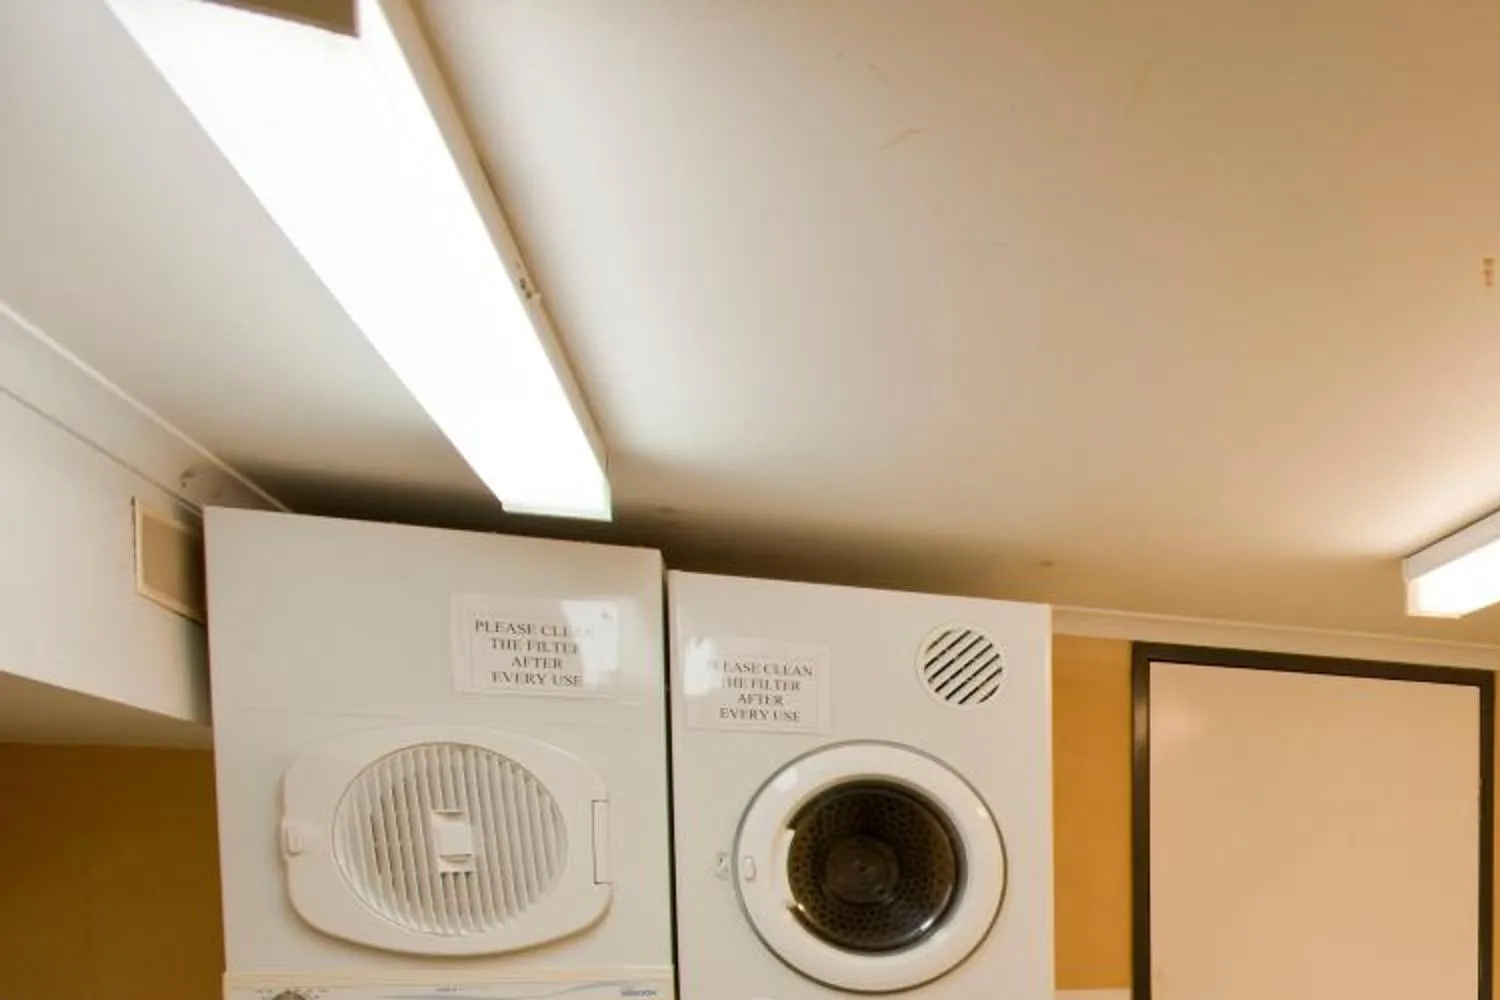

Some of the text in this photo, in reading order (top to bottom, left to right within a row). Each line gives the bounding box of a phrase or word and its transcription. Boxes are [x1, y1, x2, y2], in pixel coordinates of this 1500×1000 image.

[475, 618, 592, 638] PLEASE CLE
[490, 638, 521, 651] THE
[511, 656, 563, 669] AFTER
[706, 660, 814, 677] EASE CLEAN
[491, 671, 583, 687] EVERY USE
[751, 677, 802, 692] FILTER
[737, 693, 784, 706] AFTER
[719, 706, 802, 723] EVERY USE
